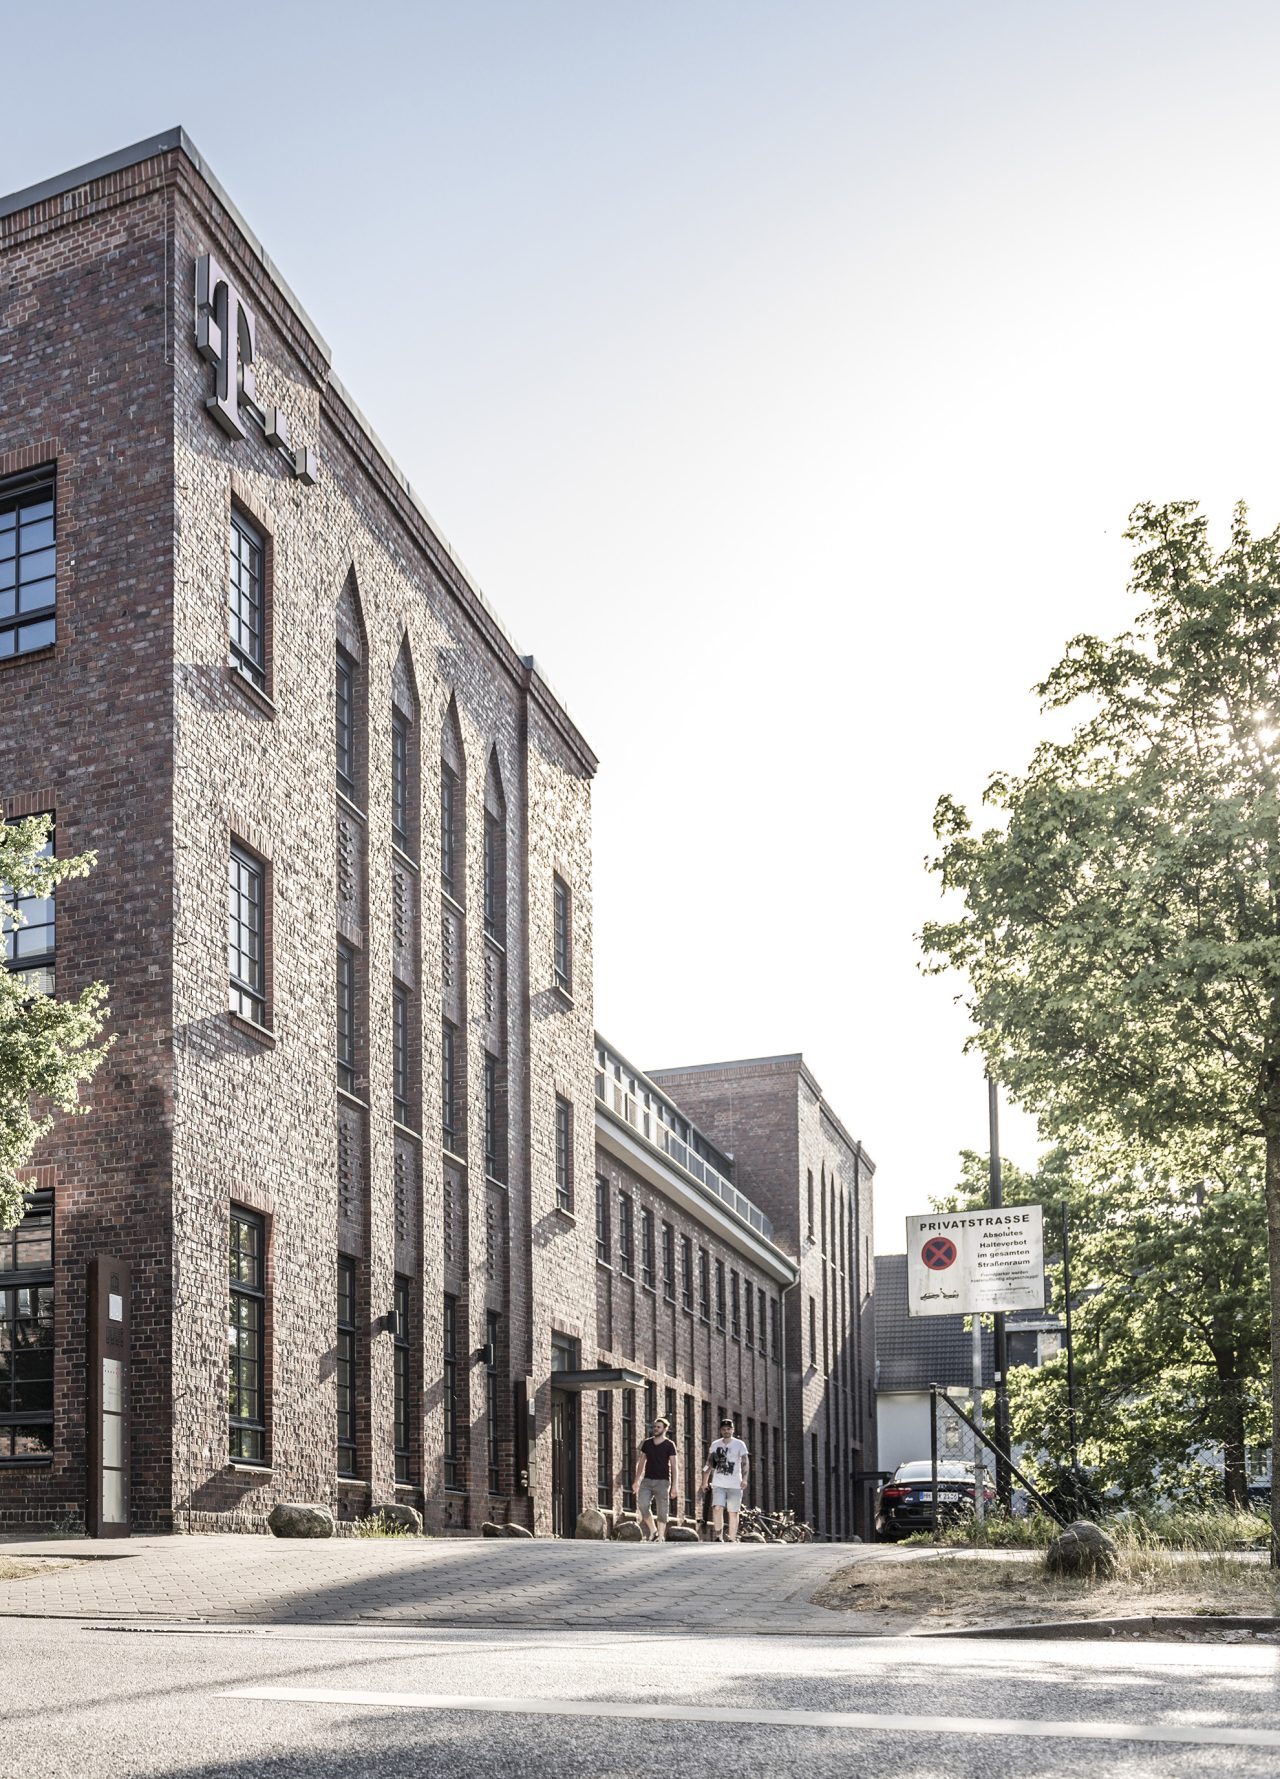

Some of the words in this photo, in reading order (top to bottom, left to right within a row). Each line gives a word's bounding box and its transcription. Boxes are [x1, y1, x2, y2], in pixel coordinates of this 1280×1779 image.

[920, 1213, 1030, 1231] PRIVATSTRASSE
[983, 1230, 1024, 1239] Absolutes
[979, 1239, 1027, 1248] Halteverbot
[989, 1250, 1030, 1259] gesamten
[977, 1260, 1030, 1268] Straßenraum
